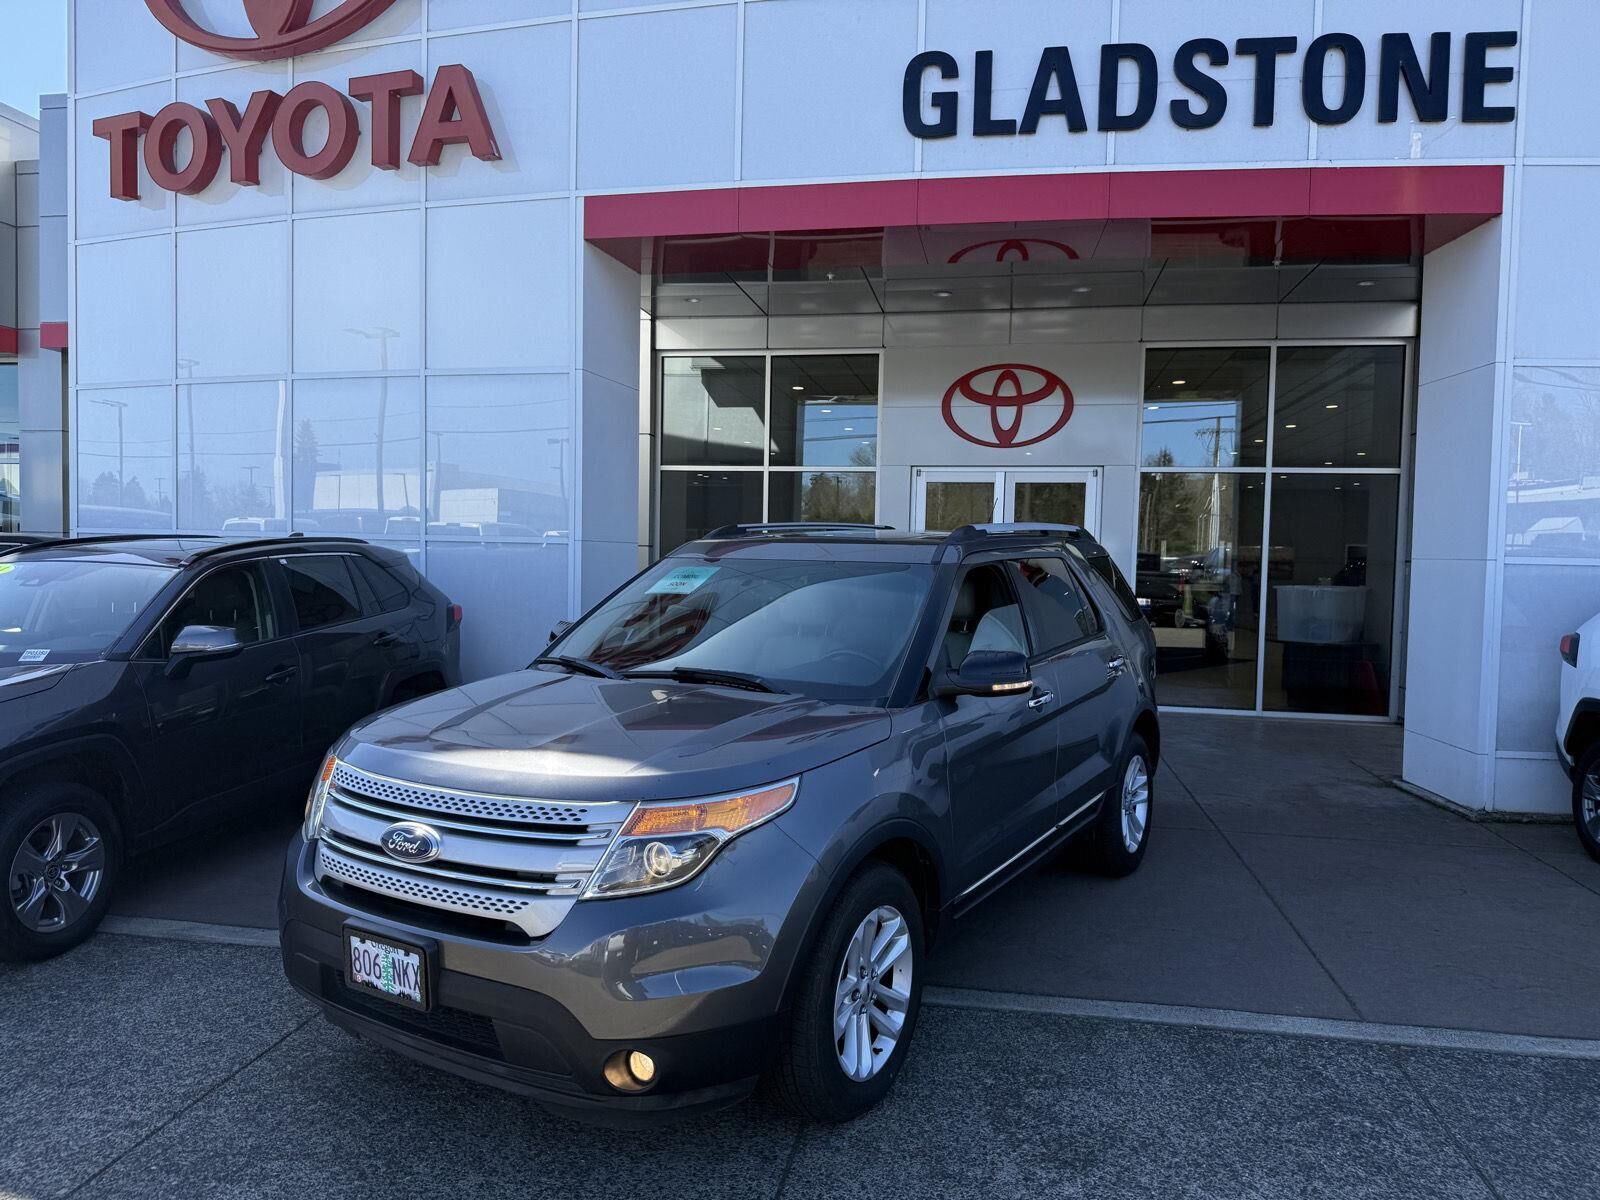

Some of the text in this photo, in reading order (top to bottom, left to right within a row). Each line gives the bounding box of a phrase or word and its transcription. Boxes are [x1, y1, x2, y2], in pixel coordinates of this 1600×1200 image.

[903, 31, 1518, 138] GLADSTONE
[92, 64, 502, 201] TOYOTA
[388, 830, 421, 854] Ford
[353, 946, 421, 991] 806 NKX
